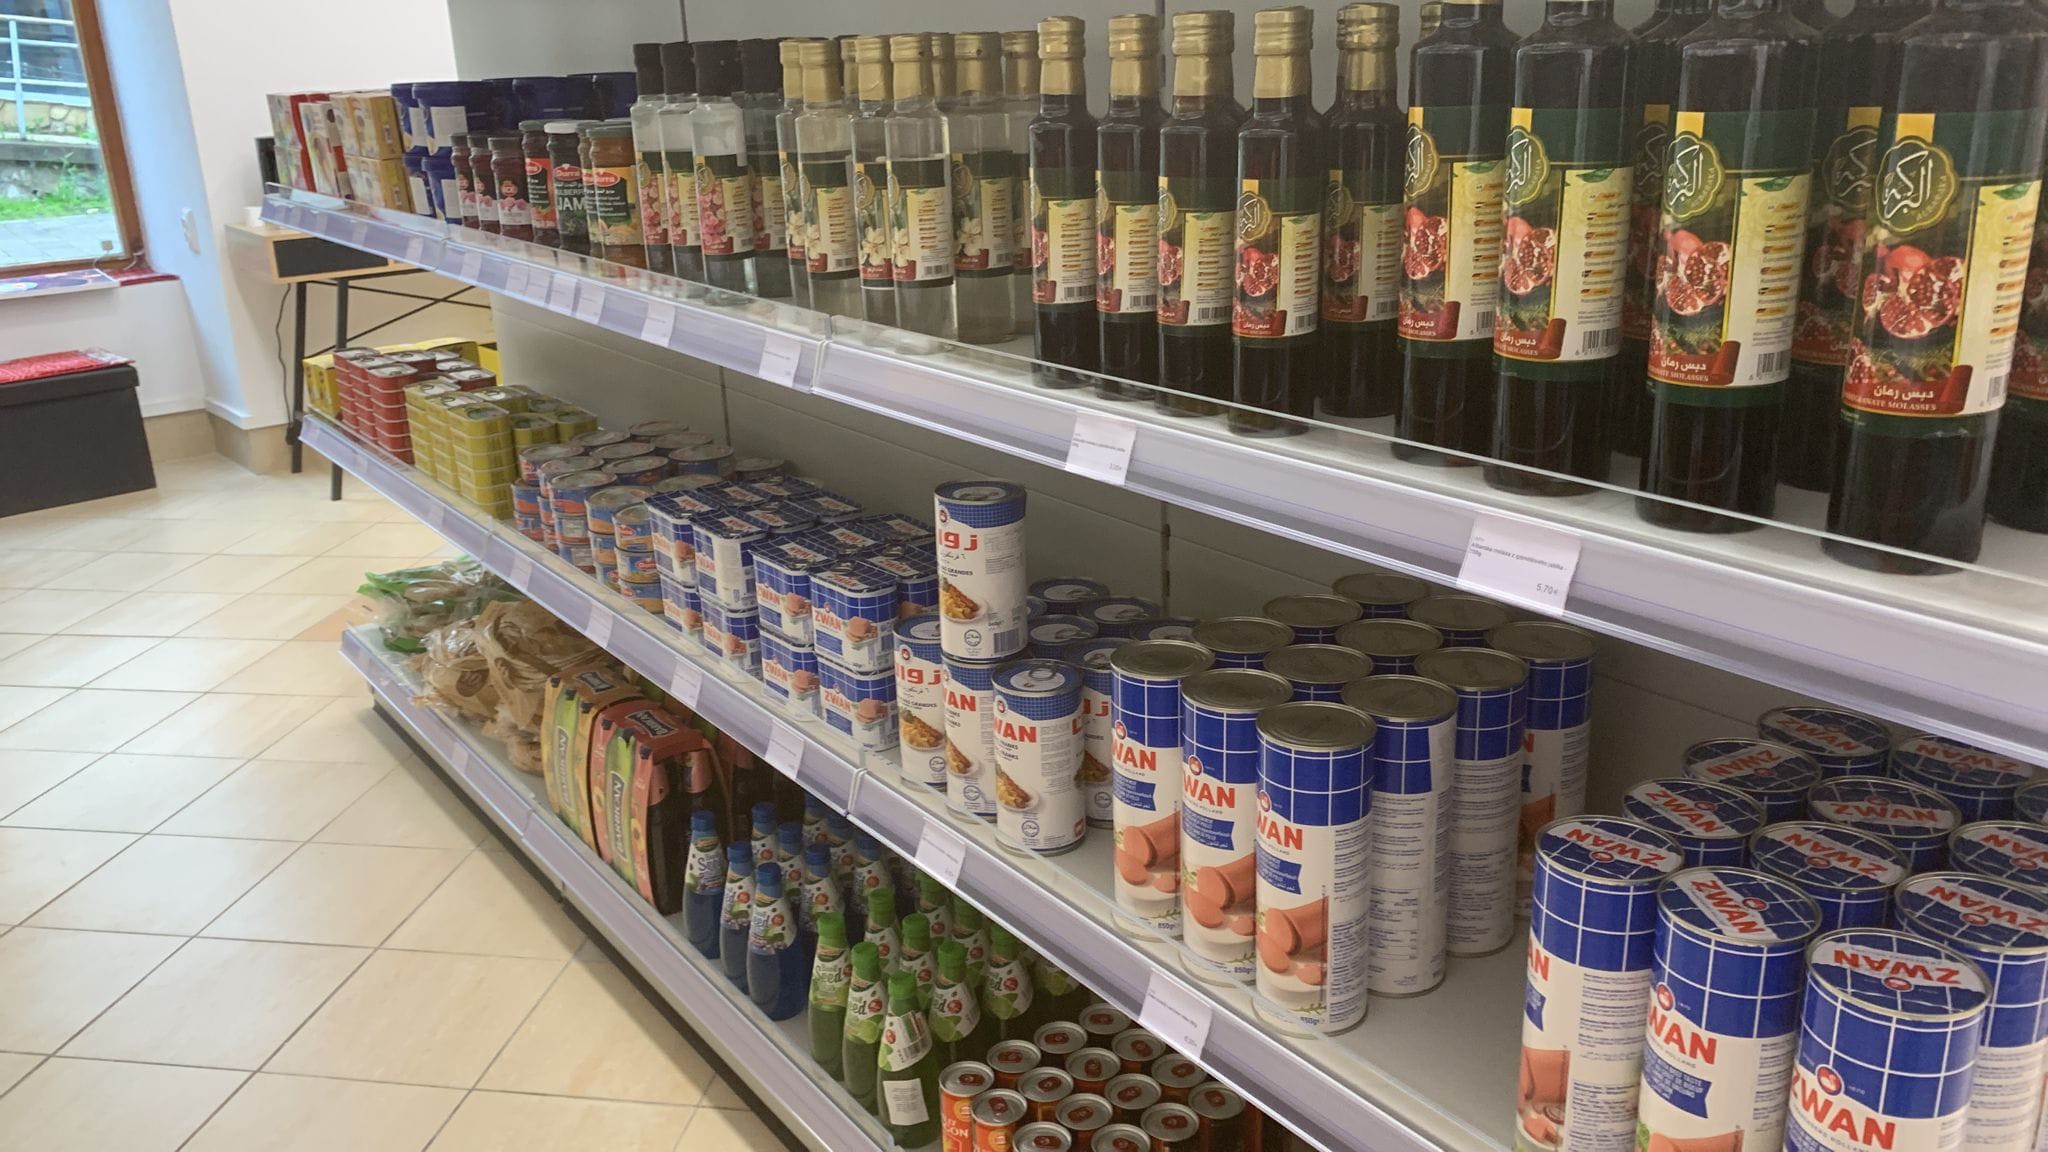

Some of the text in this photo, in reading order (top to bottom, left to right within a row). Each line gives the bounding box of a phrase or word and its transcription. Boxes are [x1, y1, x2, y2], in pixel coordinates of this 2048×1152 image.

[1514, 335, 1536, 346] دبس
[1679, 361, 1707, 373] دبس
[1873, 384, 1934, 401] دبس رمان
[1887, 401, 1937, 412] MOLASSES
[814, 609, 842, 631] ZWAN
[763, 661, 788, 682] ZWAN
[824, 690, 851, 712] ZWAN
[1778, 718, 1860, 752] ZWAN
[1112, 739, 1157, 772] WAN
[1706, 748, 1783, 777] ZWAN
[1915, 743, 2020, 772] ZWAN
[1183, 770, 1236, 809] WAN
[1646, 790, 1726, 834] ZWAN
[1830, 802, 1938, 823] ZWAN
[1257, 811, 1303, 851] WAN
[1566, 828, 1669, 868] ZWAN
[1784, 832, 1889, 877] ZWAN
[1690, 879, 1767, 944] ZWAN
[1928, 885, 2048, 933] ZWAN
[815, 965, 843, 984] Seed
[1833, 949, 1963, 985] ZWAN
[1648, 1005, 1718, 1065] WAN
